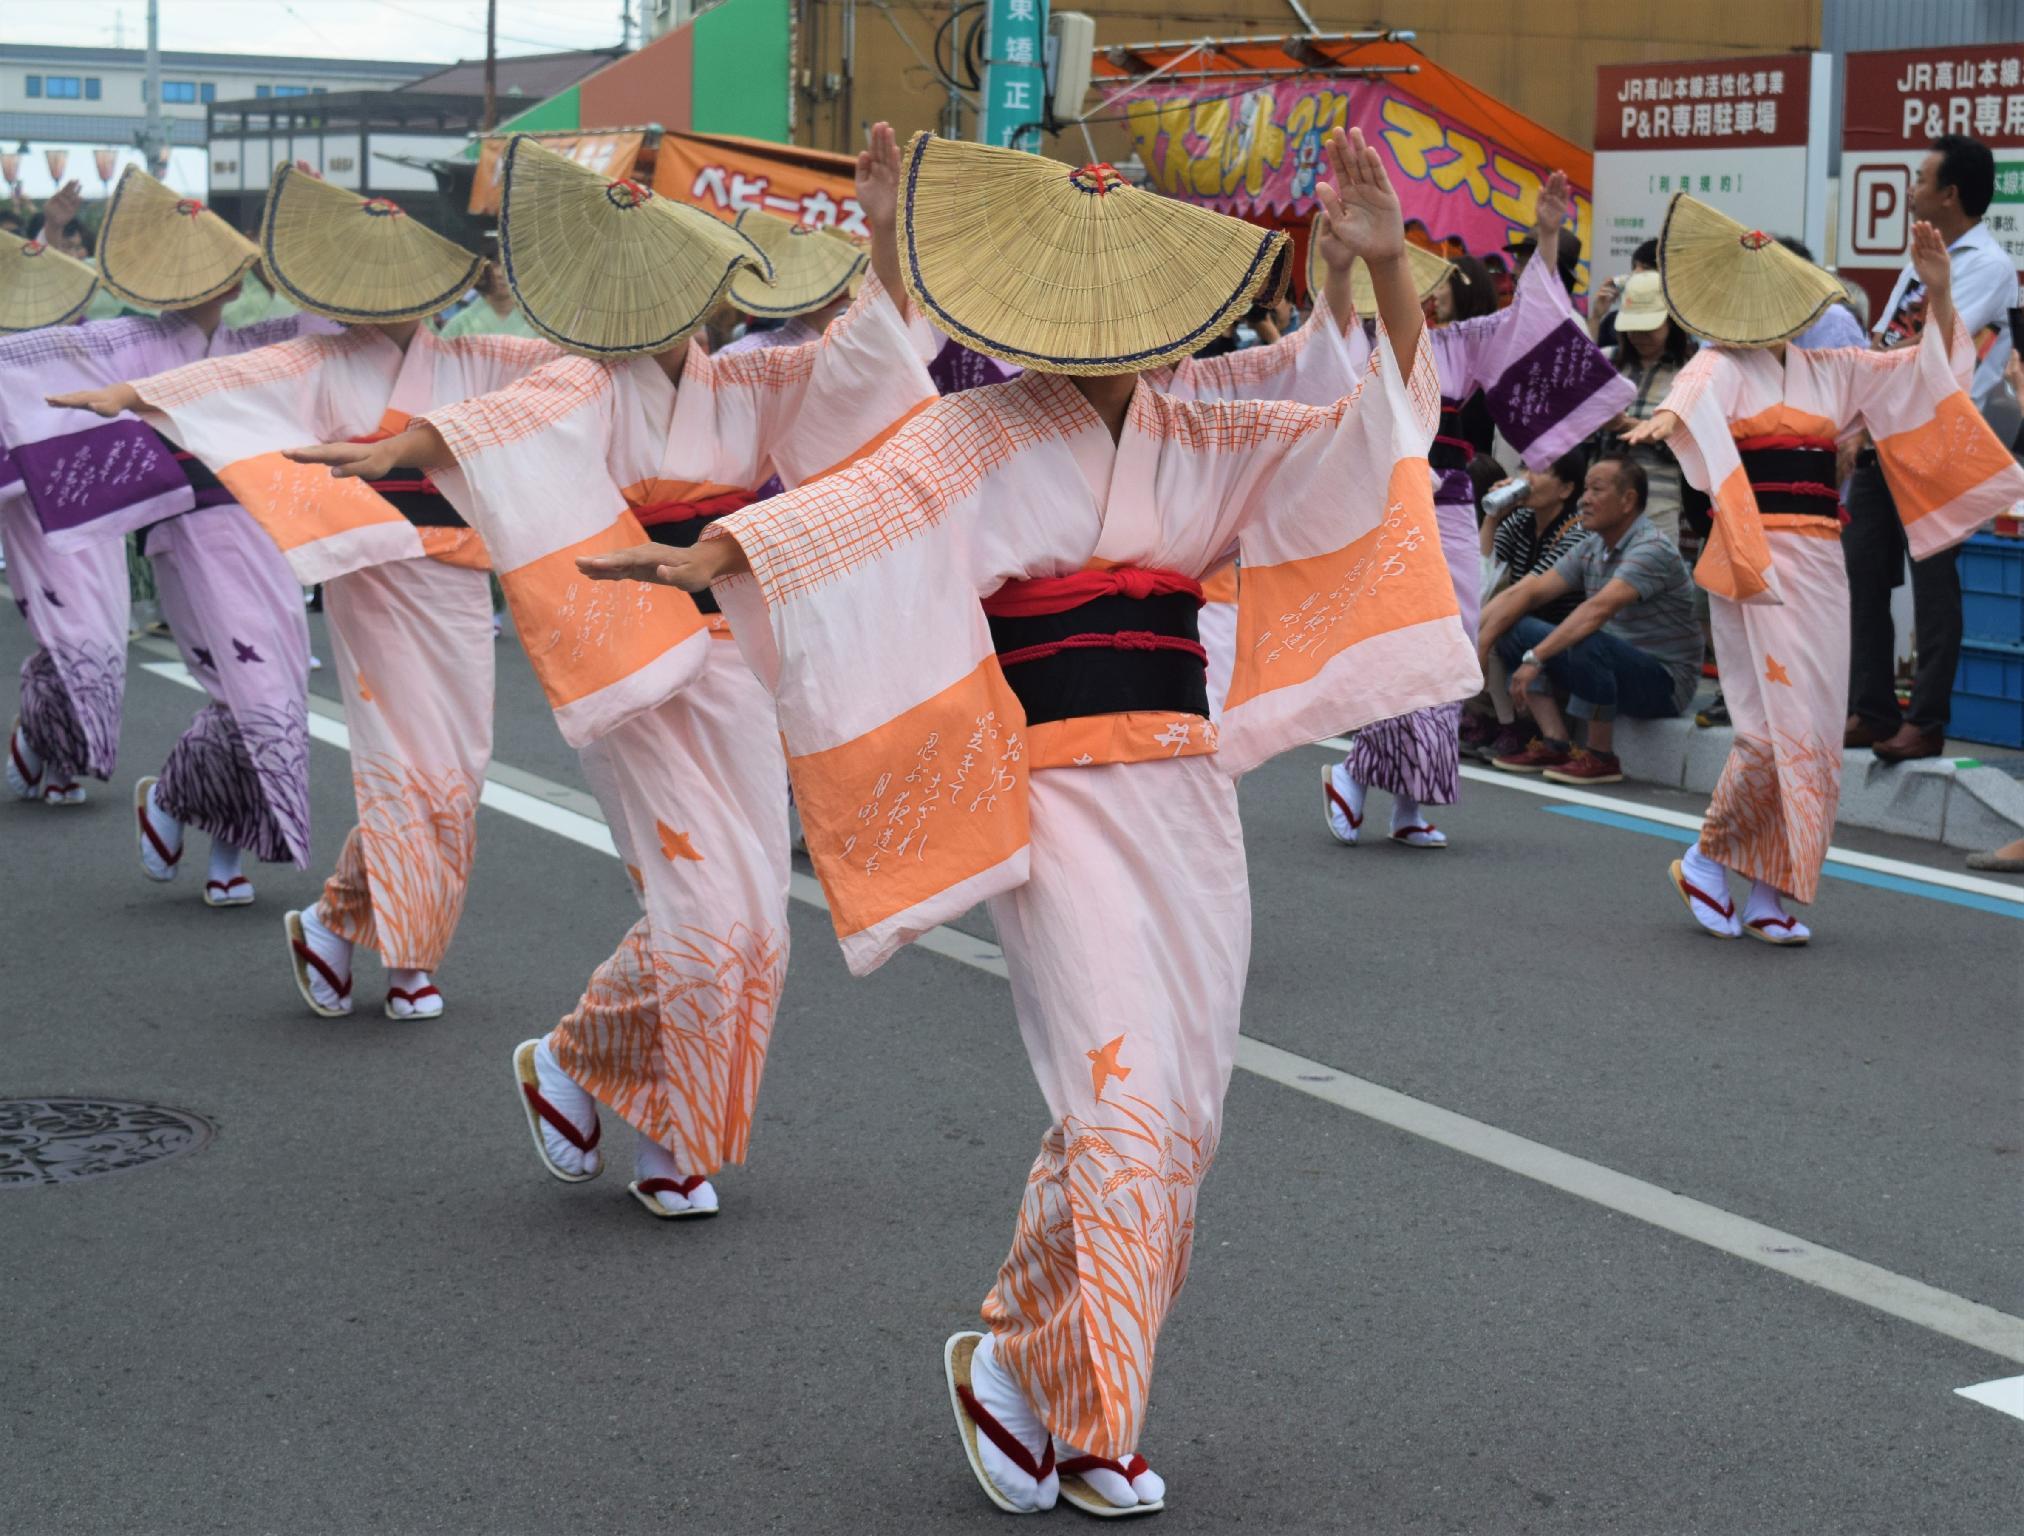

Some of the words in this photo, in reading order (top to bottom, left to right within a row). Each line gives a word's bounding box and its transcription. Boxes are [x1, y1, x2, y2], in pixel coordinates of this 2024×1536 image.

[1617, 70, 1784, 102] JR高山本線活性化事業
[1896, 57, 2024, 92] JR高山本線
[1621, 100, 1777, 139] P&R専用駐車場
[1869, 182, 1897, 240] P
